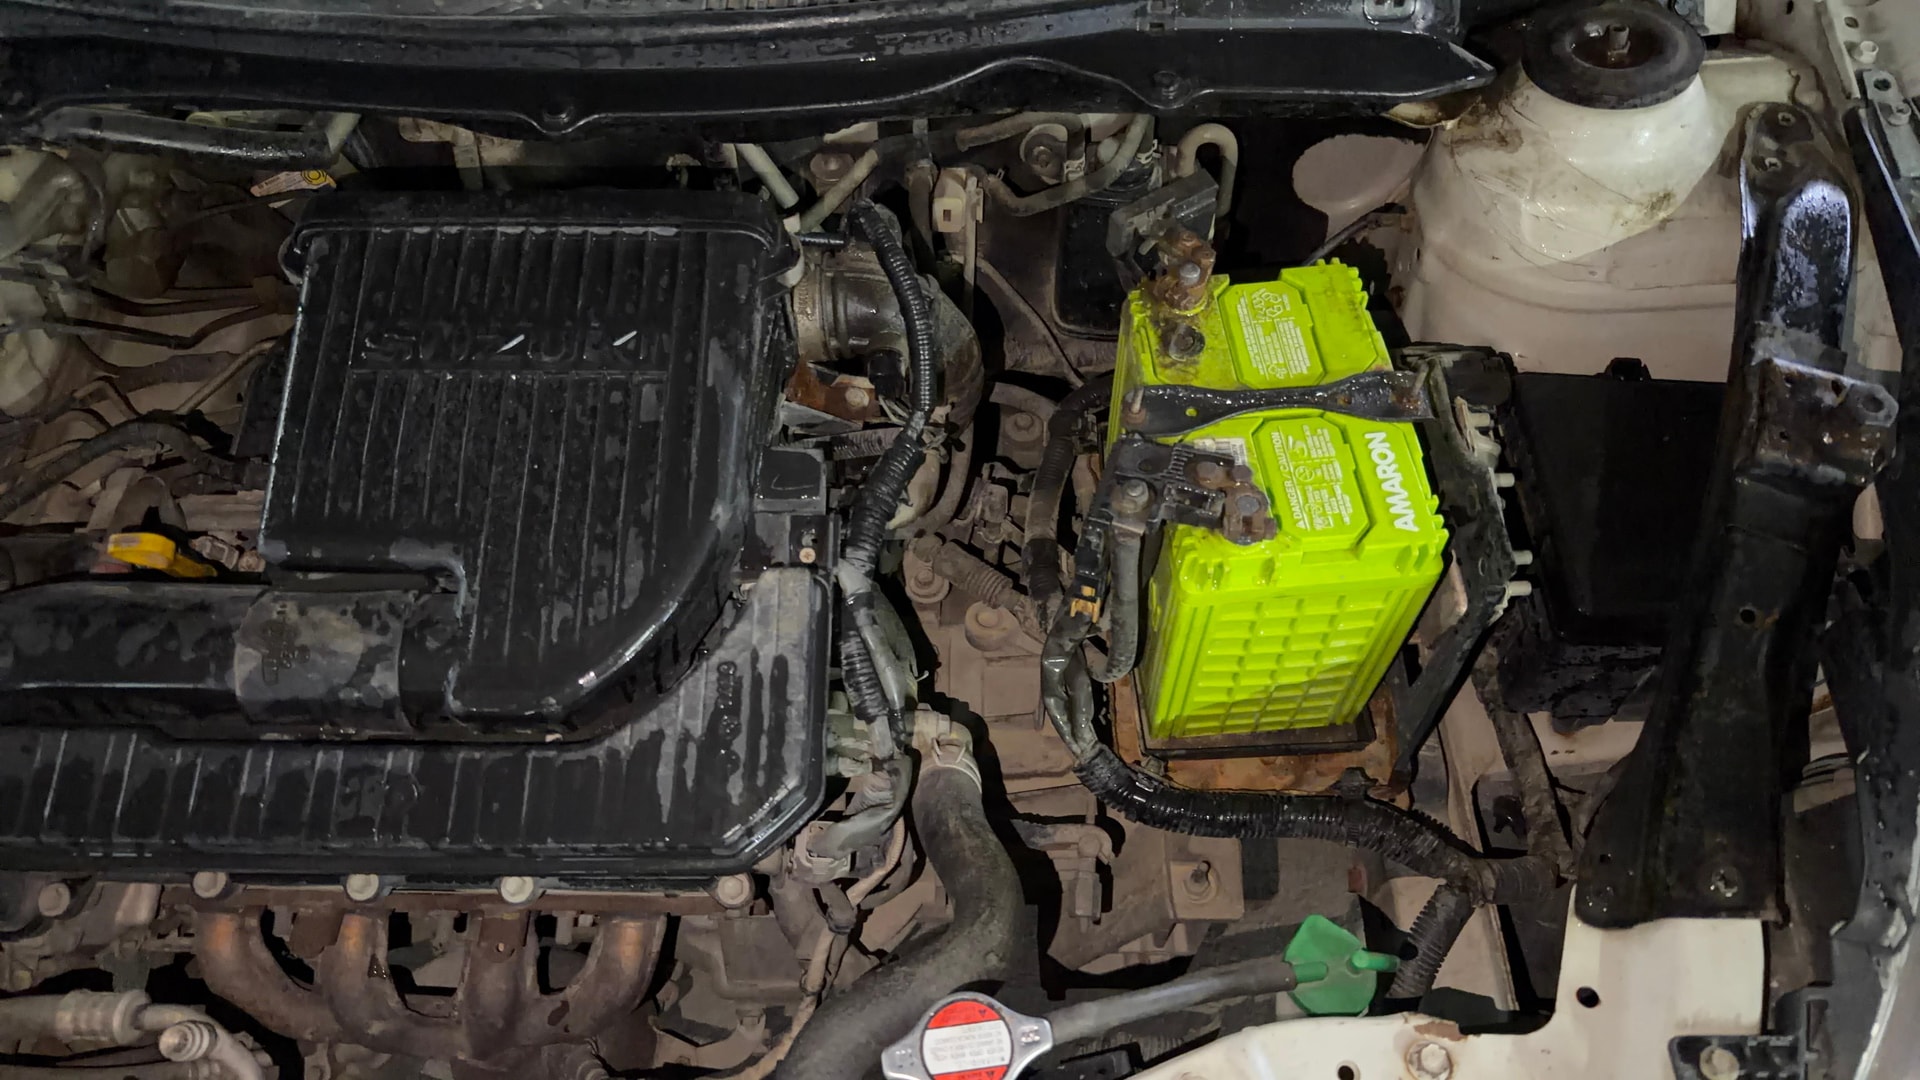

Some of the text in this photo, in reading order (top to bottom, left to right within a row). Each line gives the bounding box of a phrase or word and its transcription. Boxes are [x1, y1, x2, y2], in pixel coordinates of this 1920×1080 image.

[361, 331, 656, 362] SUZUKI
[1271, 432, 1289, 471] CAUTION
[1284, 480, 1302, 518] DANGER
[1365, 432, 1419, 532] AMARON
